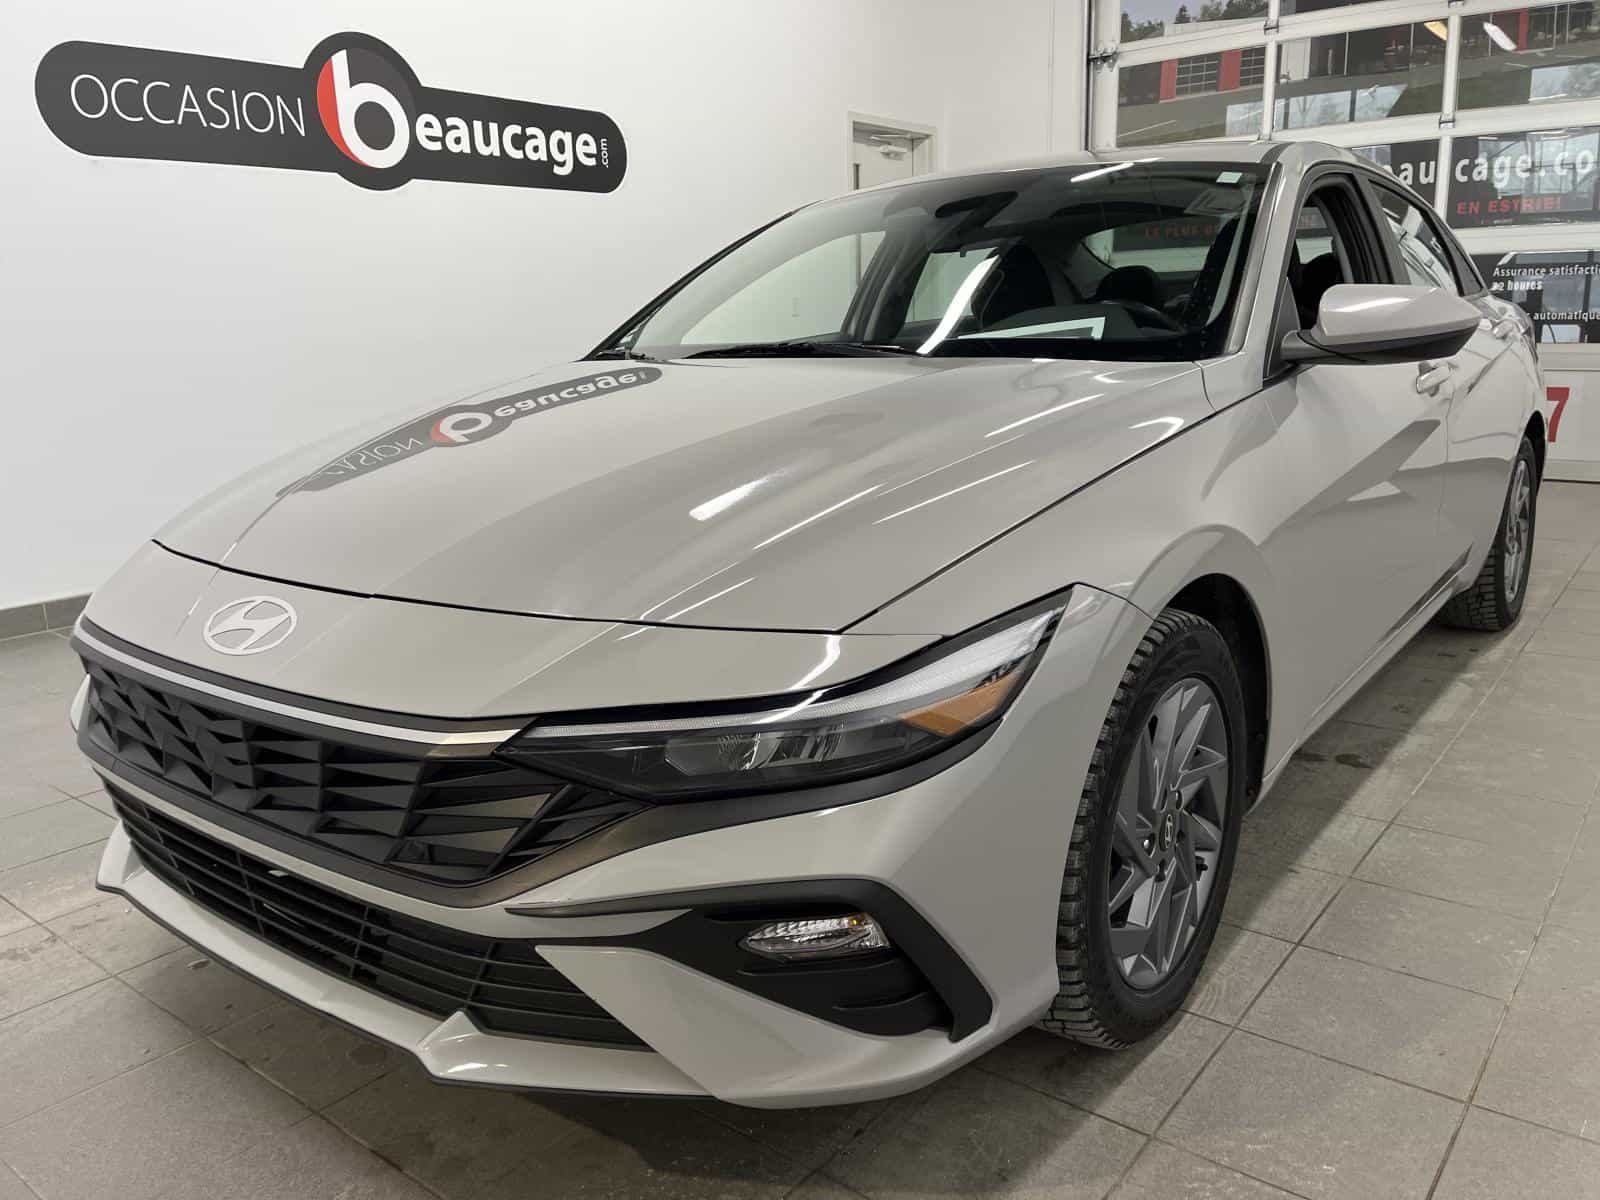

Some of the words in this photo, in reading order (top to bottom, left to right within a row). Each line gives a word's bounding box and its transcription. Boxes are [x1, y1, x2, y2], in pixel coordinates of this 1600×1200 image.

[70, 73, 305, 137] OCCASION
[1456, 201, 1480, 214] EN
[1492, 266, 1546, 277] Assurance
[1550, 264, 1600, 275] satisfacti
[1507, 280, 1543, 291] heures
[1546, 387, 1570, 443] 7
